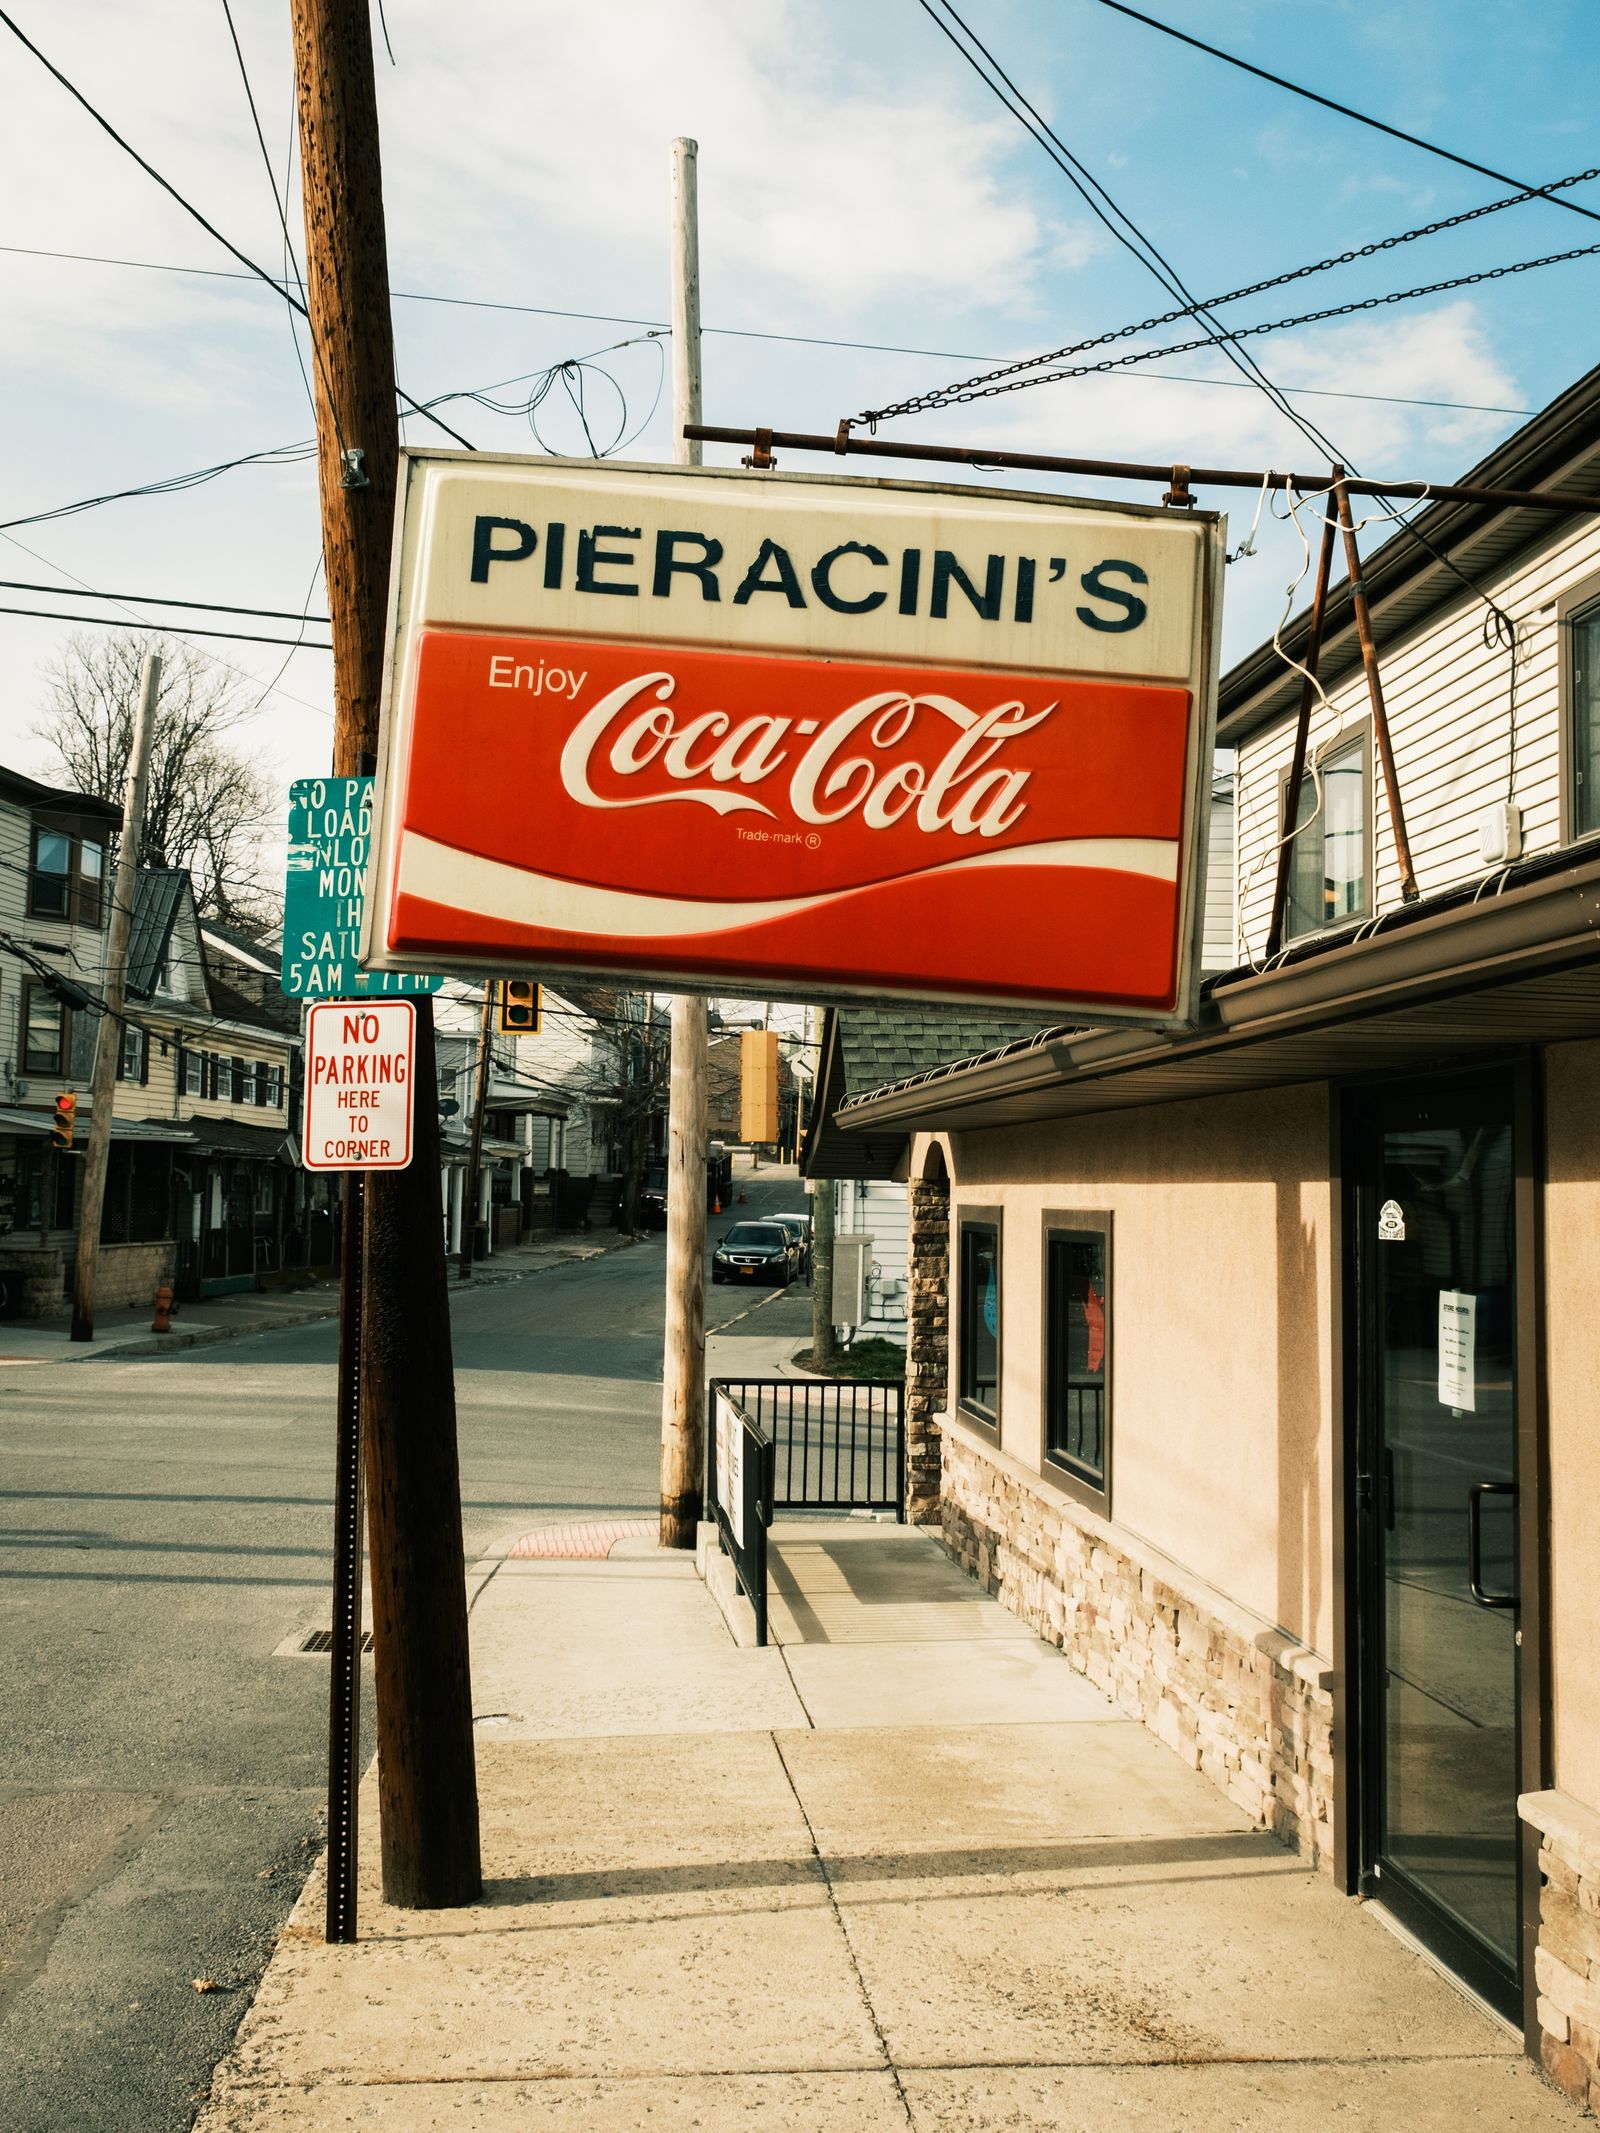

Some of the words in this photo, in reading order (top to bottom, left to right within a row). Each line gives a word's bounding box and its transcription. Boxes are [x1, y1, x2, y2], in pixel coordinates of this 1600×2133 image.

[470, 515, 1148, 632] PIERACINI’S
[489, 656, 587, 699] Enjoy
[560, 671, 1060, 838] Coca-Cola
[307, 808, 371, 839] LOAD
[736, 828, 802, 844] Trade-mark
[319, 868, 367, 897] MON
[337, 899, 361, 927] TH
[290, 964, 342, 992] 5AM
[343, 1015, 380, 1044] NO
[314, 1054, 406, 1085] PARKING
[338, 1090, 380, 1108] HERE
[349, 1115, 369, 1133] TO
[325, 1140, 390, 1158] CORNER
